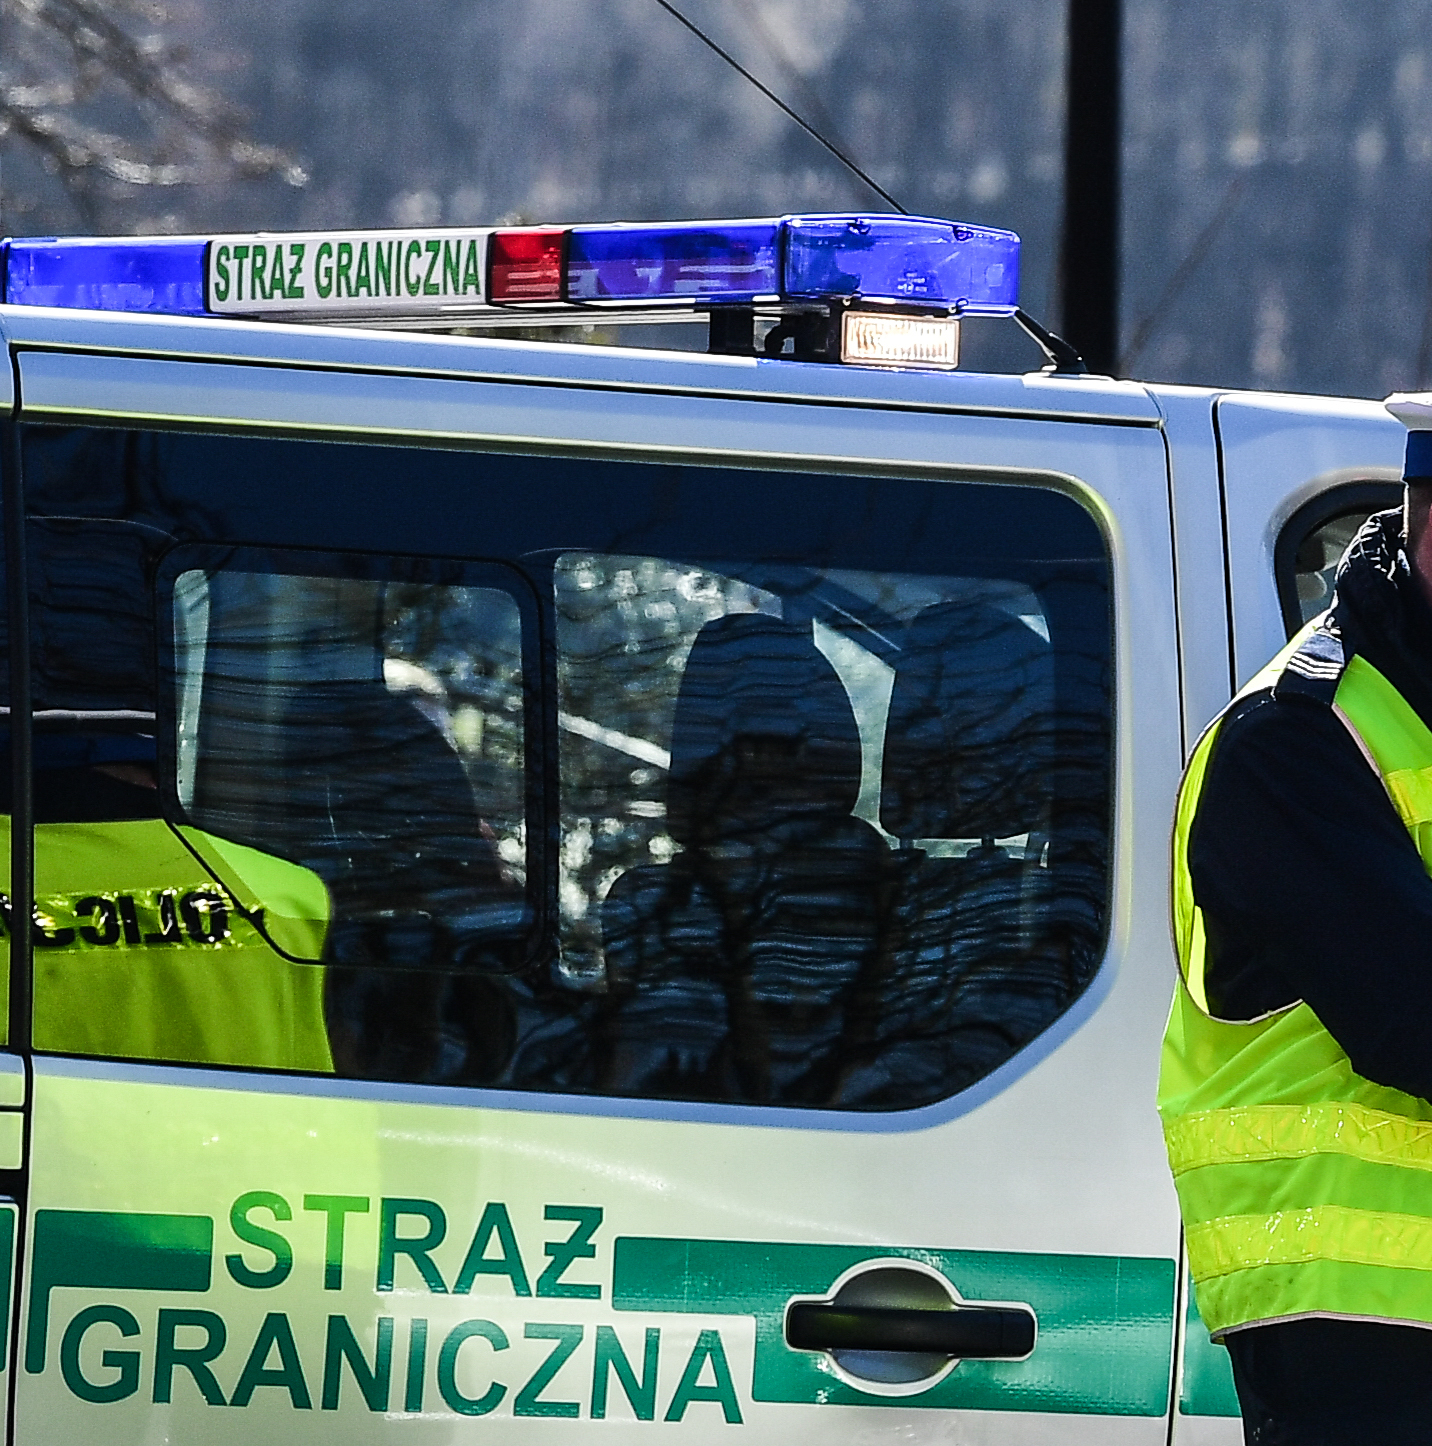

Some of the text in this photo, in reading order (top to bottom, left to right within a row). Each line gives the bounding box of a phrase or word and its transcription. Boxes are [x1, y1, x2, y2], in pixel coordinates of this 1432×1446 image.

[214, 239, 482, 302] STRAŻ GRANICZNA
[224, 1190, 603, 1300] STRAŻ
[60, 1303, 745, 1425] GRANICZNA
